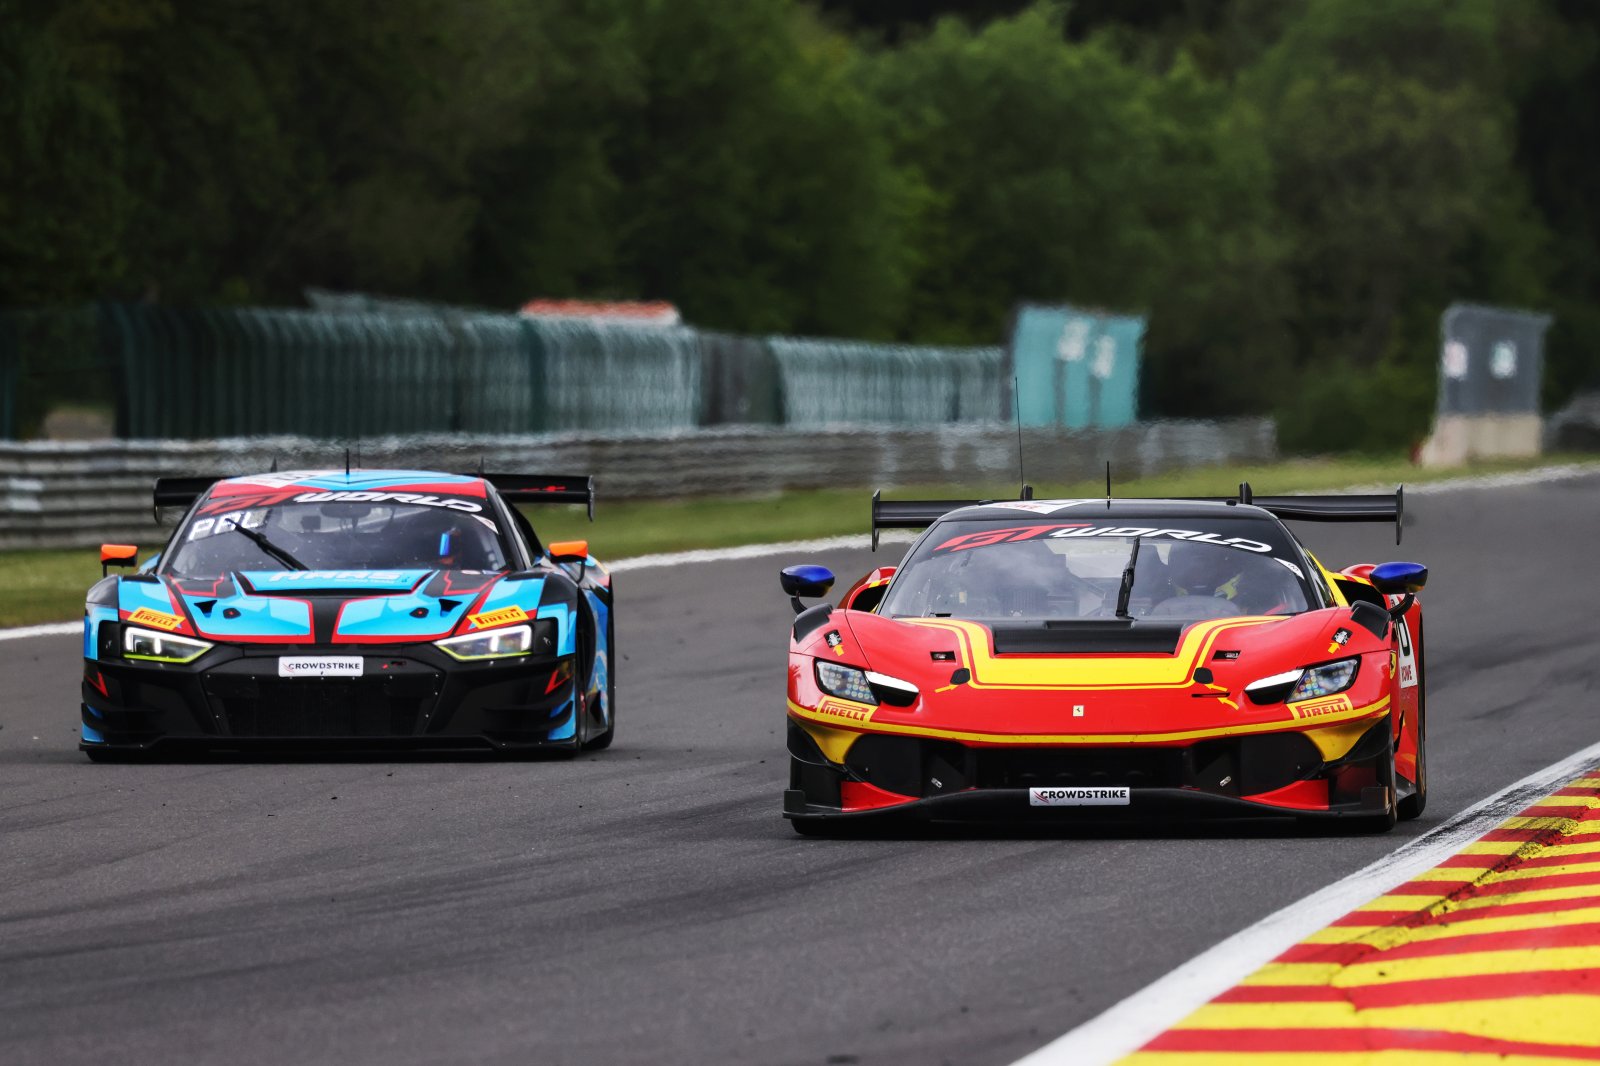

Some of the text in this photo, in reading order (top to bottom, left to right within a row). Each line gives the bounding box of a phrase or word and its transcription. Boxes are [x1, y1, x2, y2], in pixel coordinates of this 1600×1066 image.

[196, 490, 483, 516] GT WORLD
[934, 523, 1273, 553] GT WORLD
[133, 610, 179, 627] PIRELLI
[474, 608, 522, 625] PIRELLI
[288, 662, 360, 670] CROWDSTRIKE
[819, 700, 870, 722] PIRELLI
[1295, 697, 1349, 719] PIRELLI
[1040, 789, 1127, 799] CROWDSTRIKE
